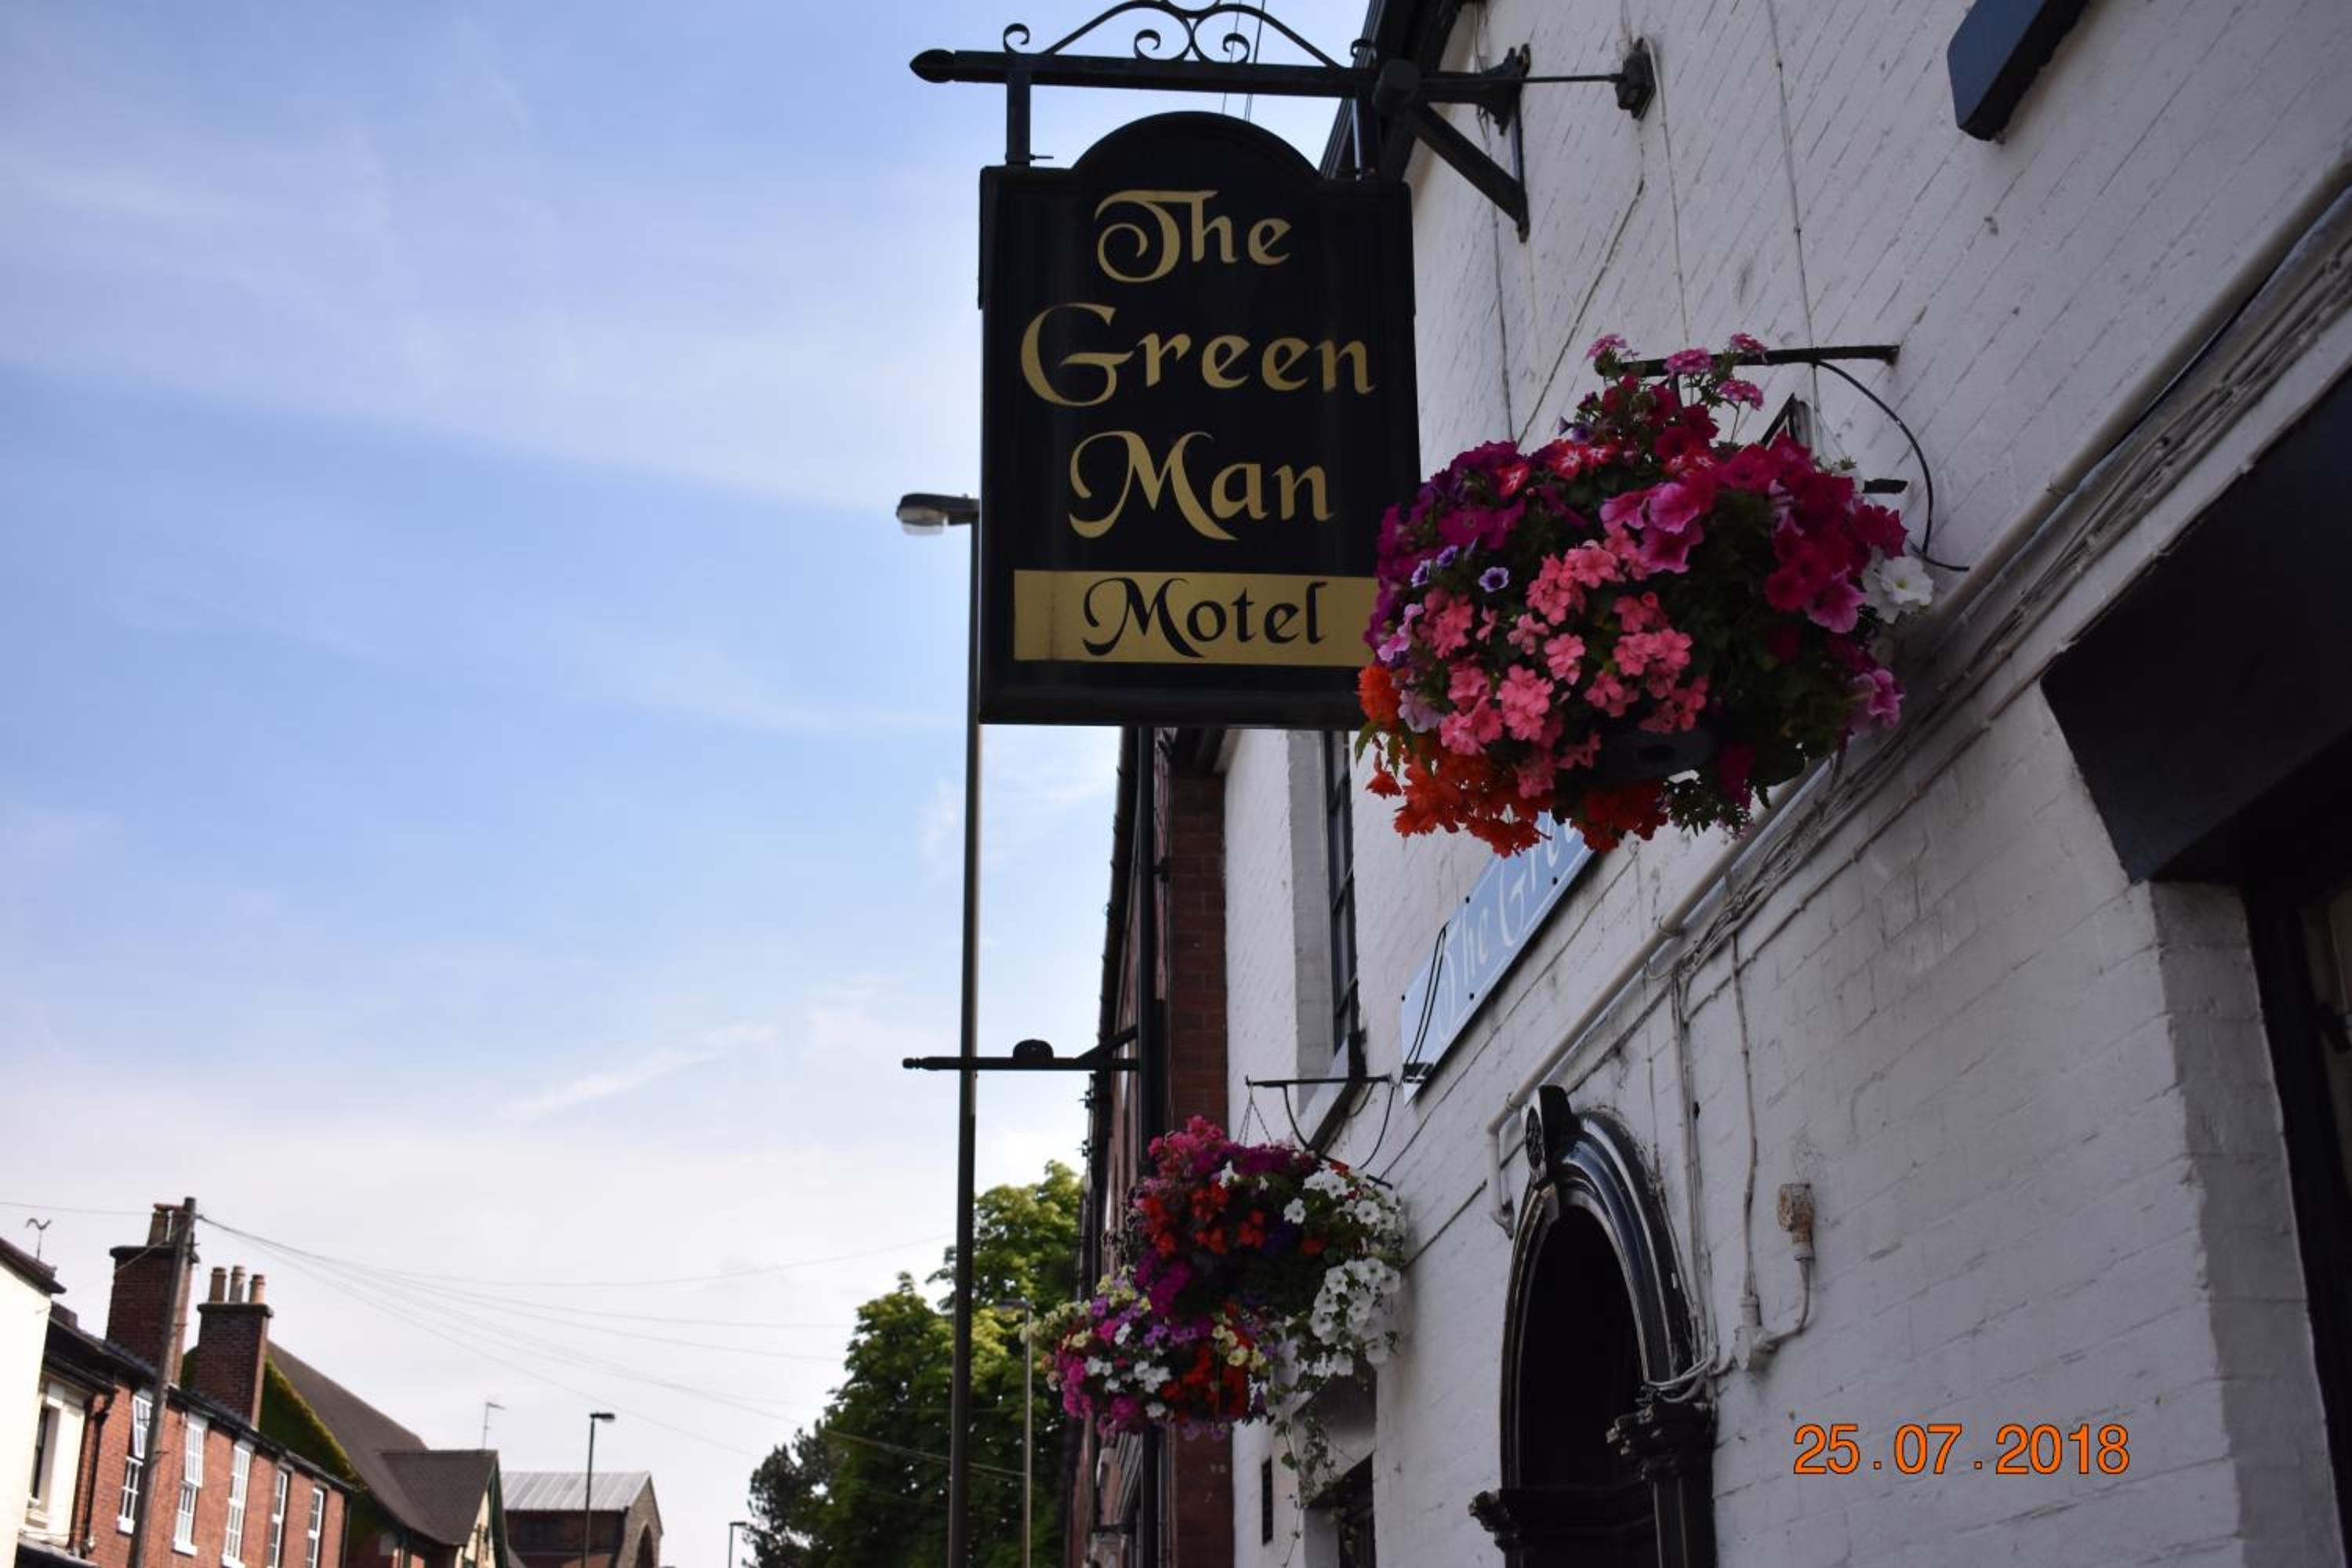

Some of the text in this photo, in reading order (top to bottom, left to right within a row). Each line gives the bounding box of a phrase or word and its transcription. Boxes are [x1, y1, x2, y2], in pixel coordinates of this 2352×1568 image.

[1094, 189, 1292, 282] The
[1022, 303, 1376, 406] Green
[1069, 430, 1333, 540] Man
[1082, 577, 1328, 657] Motel
[1435, 905, 1489, 1041] The
